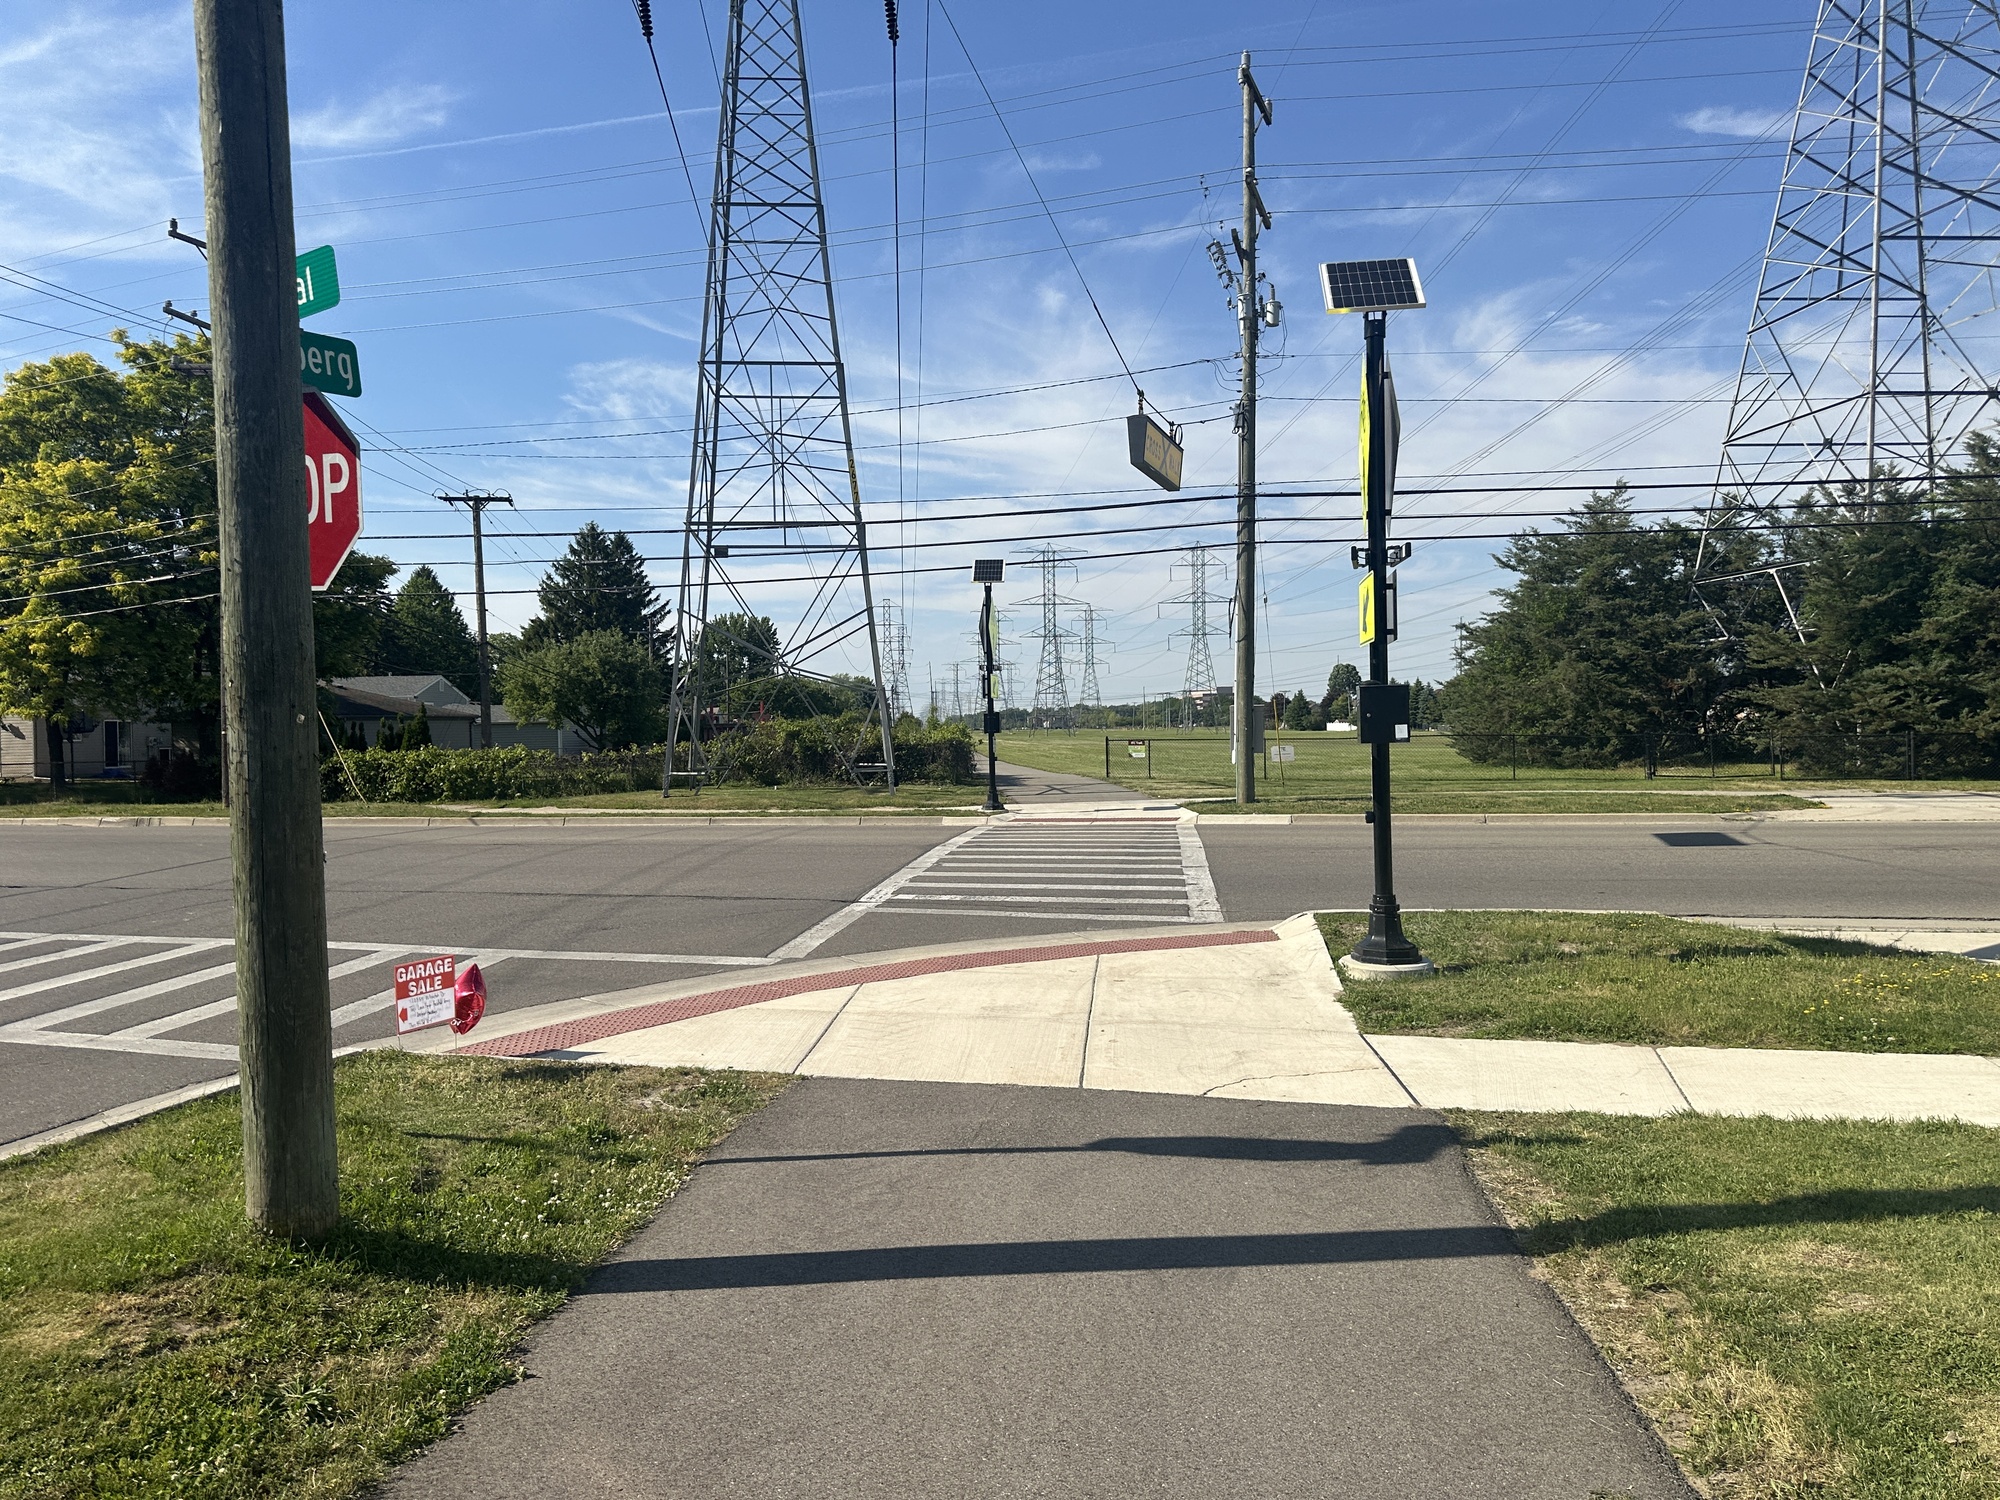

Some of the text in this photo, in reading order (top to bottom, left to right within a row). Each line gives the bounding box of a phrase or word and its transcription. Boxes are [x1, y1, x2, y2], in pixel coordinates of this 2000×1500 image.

[849, 459, 858, 500] 2677
[397, 958, 452, 982] GARAGE
[408, 976, 443, 996] SALE
